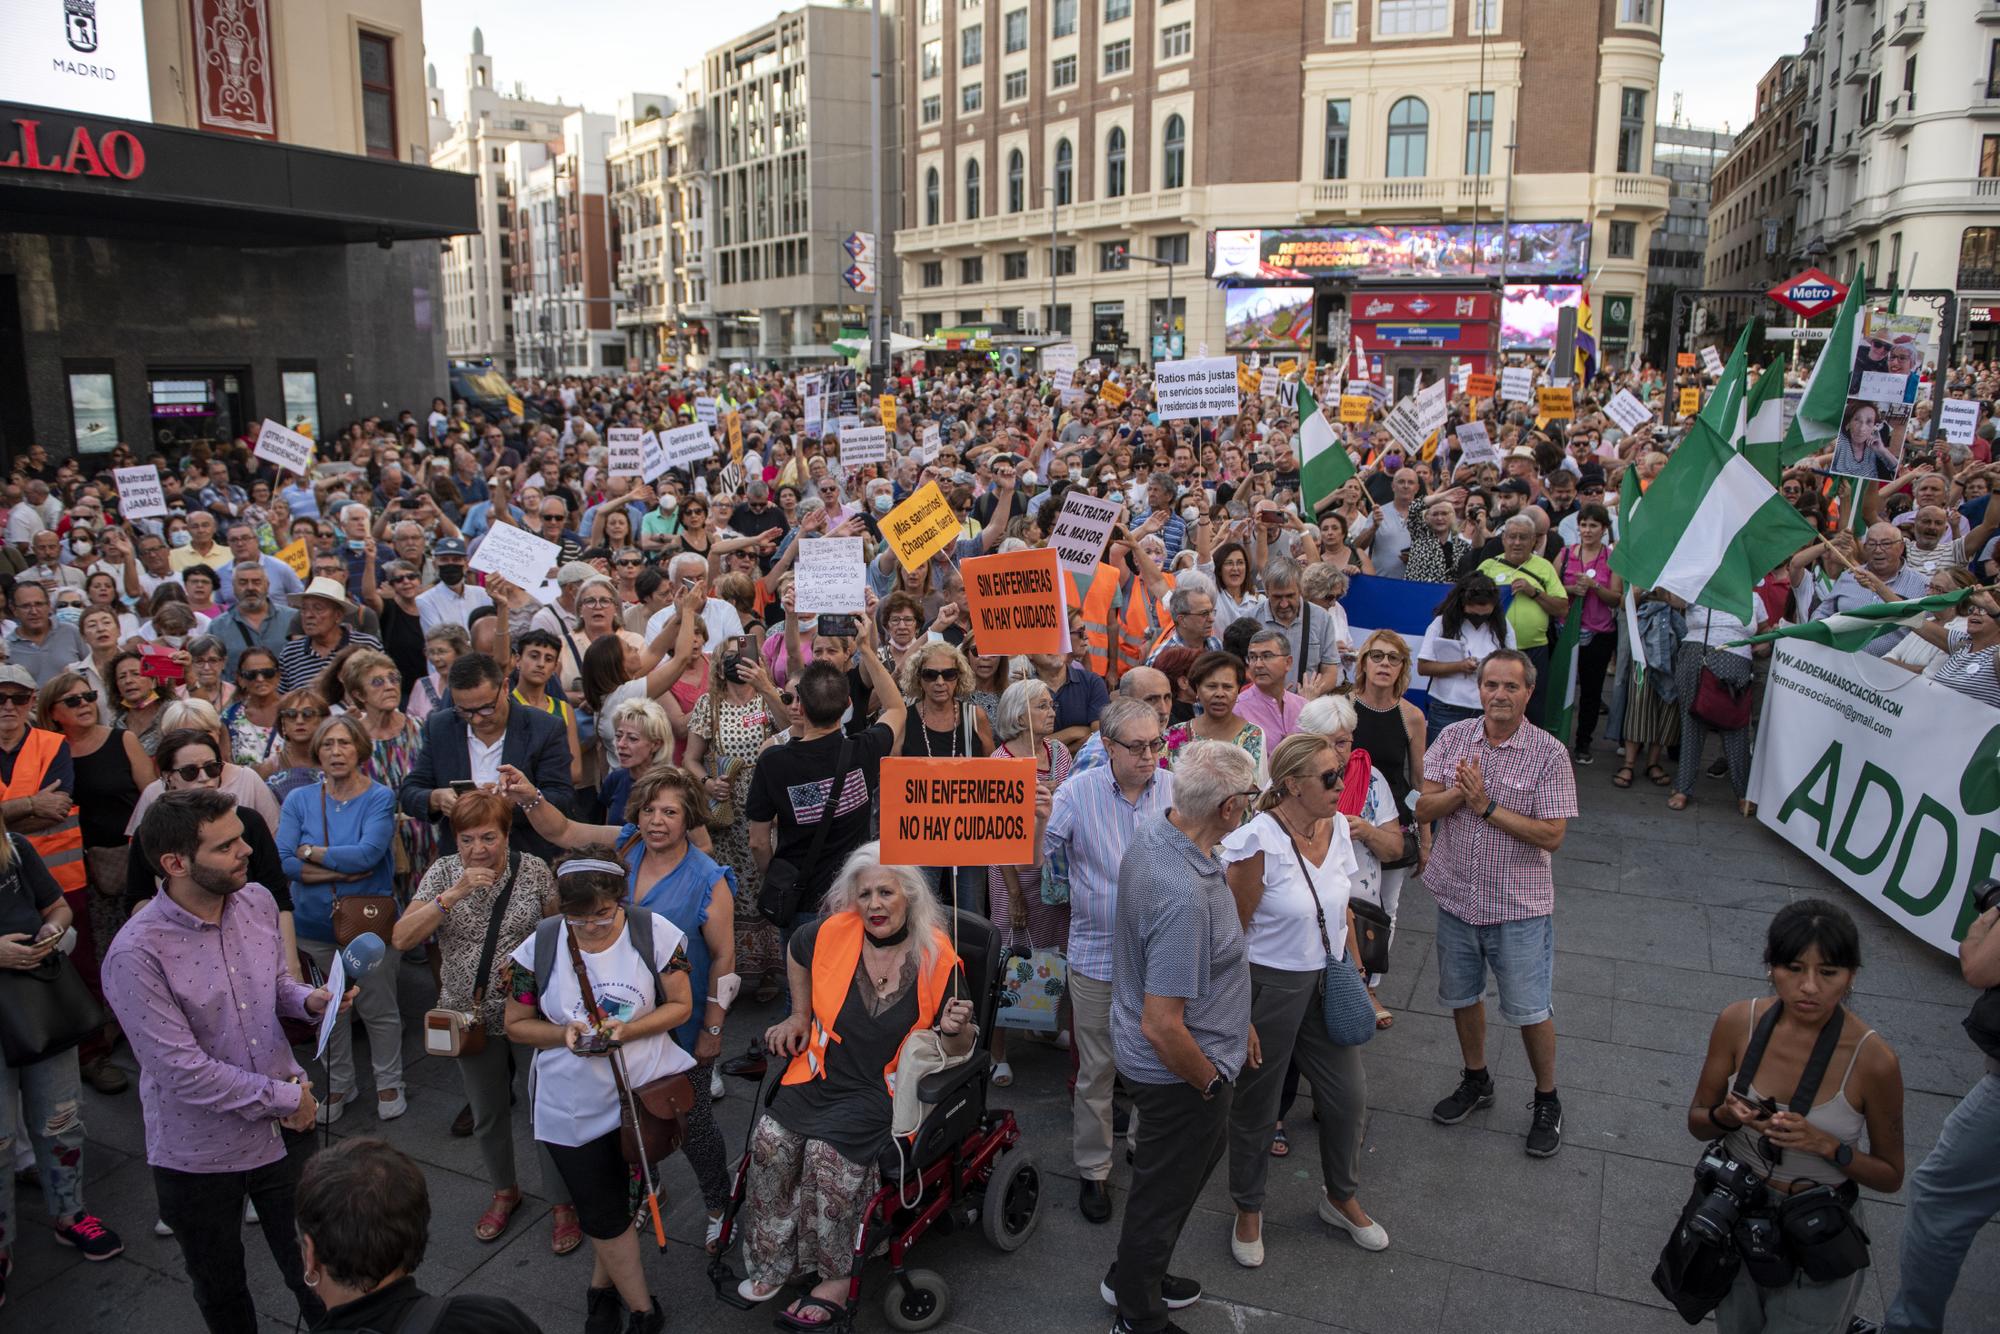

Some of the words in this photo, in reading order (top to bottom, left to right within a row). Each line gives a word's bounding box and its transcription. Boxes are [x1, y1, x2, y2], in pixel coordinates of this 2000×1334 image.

[53, 58, 116, 81] MADRID
[1278, 241, 1361, 254] REDESCUBRE
[1268, 255, 1292, 267] TUS
[1295, 253, 1370, 267] EMOCIONES
[1792, 287, 1830, 299] Metro
[1970, 307, 1990, 315] FIVE
[1791, 329, 1823, 338] Callao
[1158, 373, 1186, 384] Ratios
[1188, 371, 1206, 382] más
[1208, 370, 1236, 383] justas
[1159, 389, 1168, 398] en
[1170, 385, 1203, 398] servicios
[1205, 384, 1236, 395] sociales
[1159, 404, 1164, 414] y
[1164, 400, 1198, 411] residencias
[1200, 399, 1207, 409] de
[1209, 399, 1236, 411] mayores.
[1944, 405, 1975, 415] Residencias
[610, 433, 640, 442] MALTRATAR
[300, 445, 310, 456] DE
[610, 448, 617, 456] AL
[118, 471, 156, 485] Maltratar
[121, 488, 129, 497] al
[126, 497, 162, 512] ¡JAMÁS!
[1063, 500, 1115, 523] MALTRATAR
[893, 520, 911, 541] ¡Más
[909, 492, 944, 526] sanitarios!
[935, 510, 955, 531] fuera!
[1054, 523, 1067, 536] AL
[1070, 525, 1104, 547] MAYOR,
[977, 574, 992, 597] SIN
[994, 568, 1053, 596] ENFERMERAS
[980, 606, 994, 631] NO
[995, 606, 1011, 630] HAY
[1013, 604, 1058, 630] CUIDADOS.
[745, 712, 765, 723] CCOO
[905, 779, 928, 804] SIN
[931, 779, 1025, 804] ENFERMERAS
[899, 816, 920, 840] NO
[923, 816, 951, 840] HAY
[954, 816, 1027, 840] CUIDADOS.
[346, 950, 361, 969] tve
